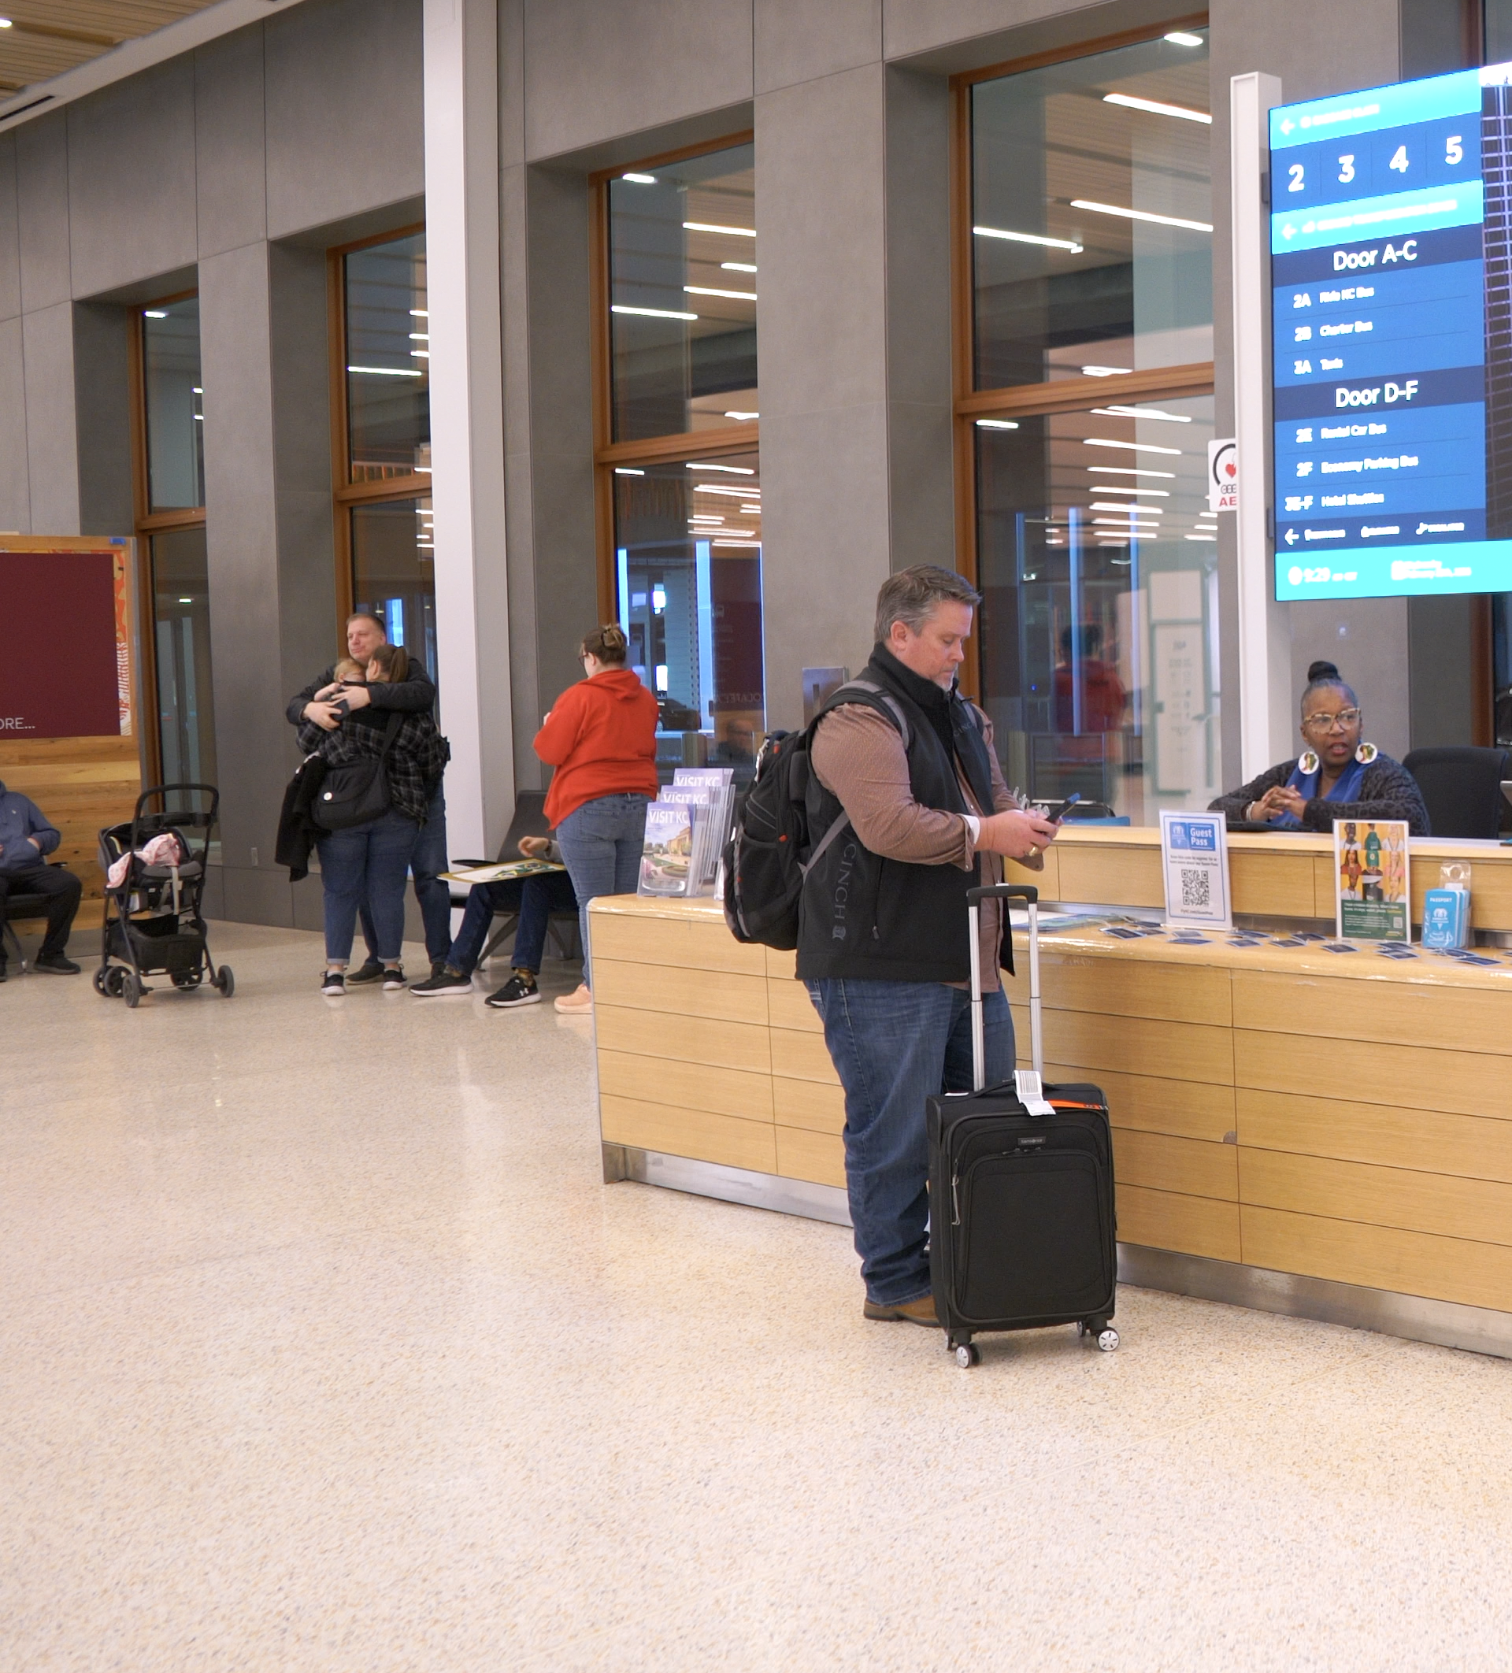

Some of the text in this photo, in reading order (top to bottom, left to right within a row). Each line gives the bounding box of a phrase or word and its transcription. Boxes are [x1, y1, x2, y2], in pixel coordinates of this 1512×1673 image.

[1288, 135, 1463, 192] 2 3 4 5
[1333, 239, 1418, 271] Door A-C
[1293, 293, 1312, 309] 2A
[1335, 380, 1419, 408] Door D-F
[1219, 496, 1237, 507] AE
[676, 776, 704, 787] VISIT
[664, 793, 691, 804] VISIT
[649, 810, 689, 825] VISIT KC
[1190, 827, 1213, 838] Guest
[1191, 837, 1208, 846] Pass
[834, 843, 857, 919] CINCH
